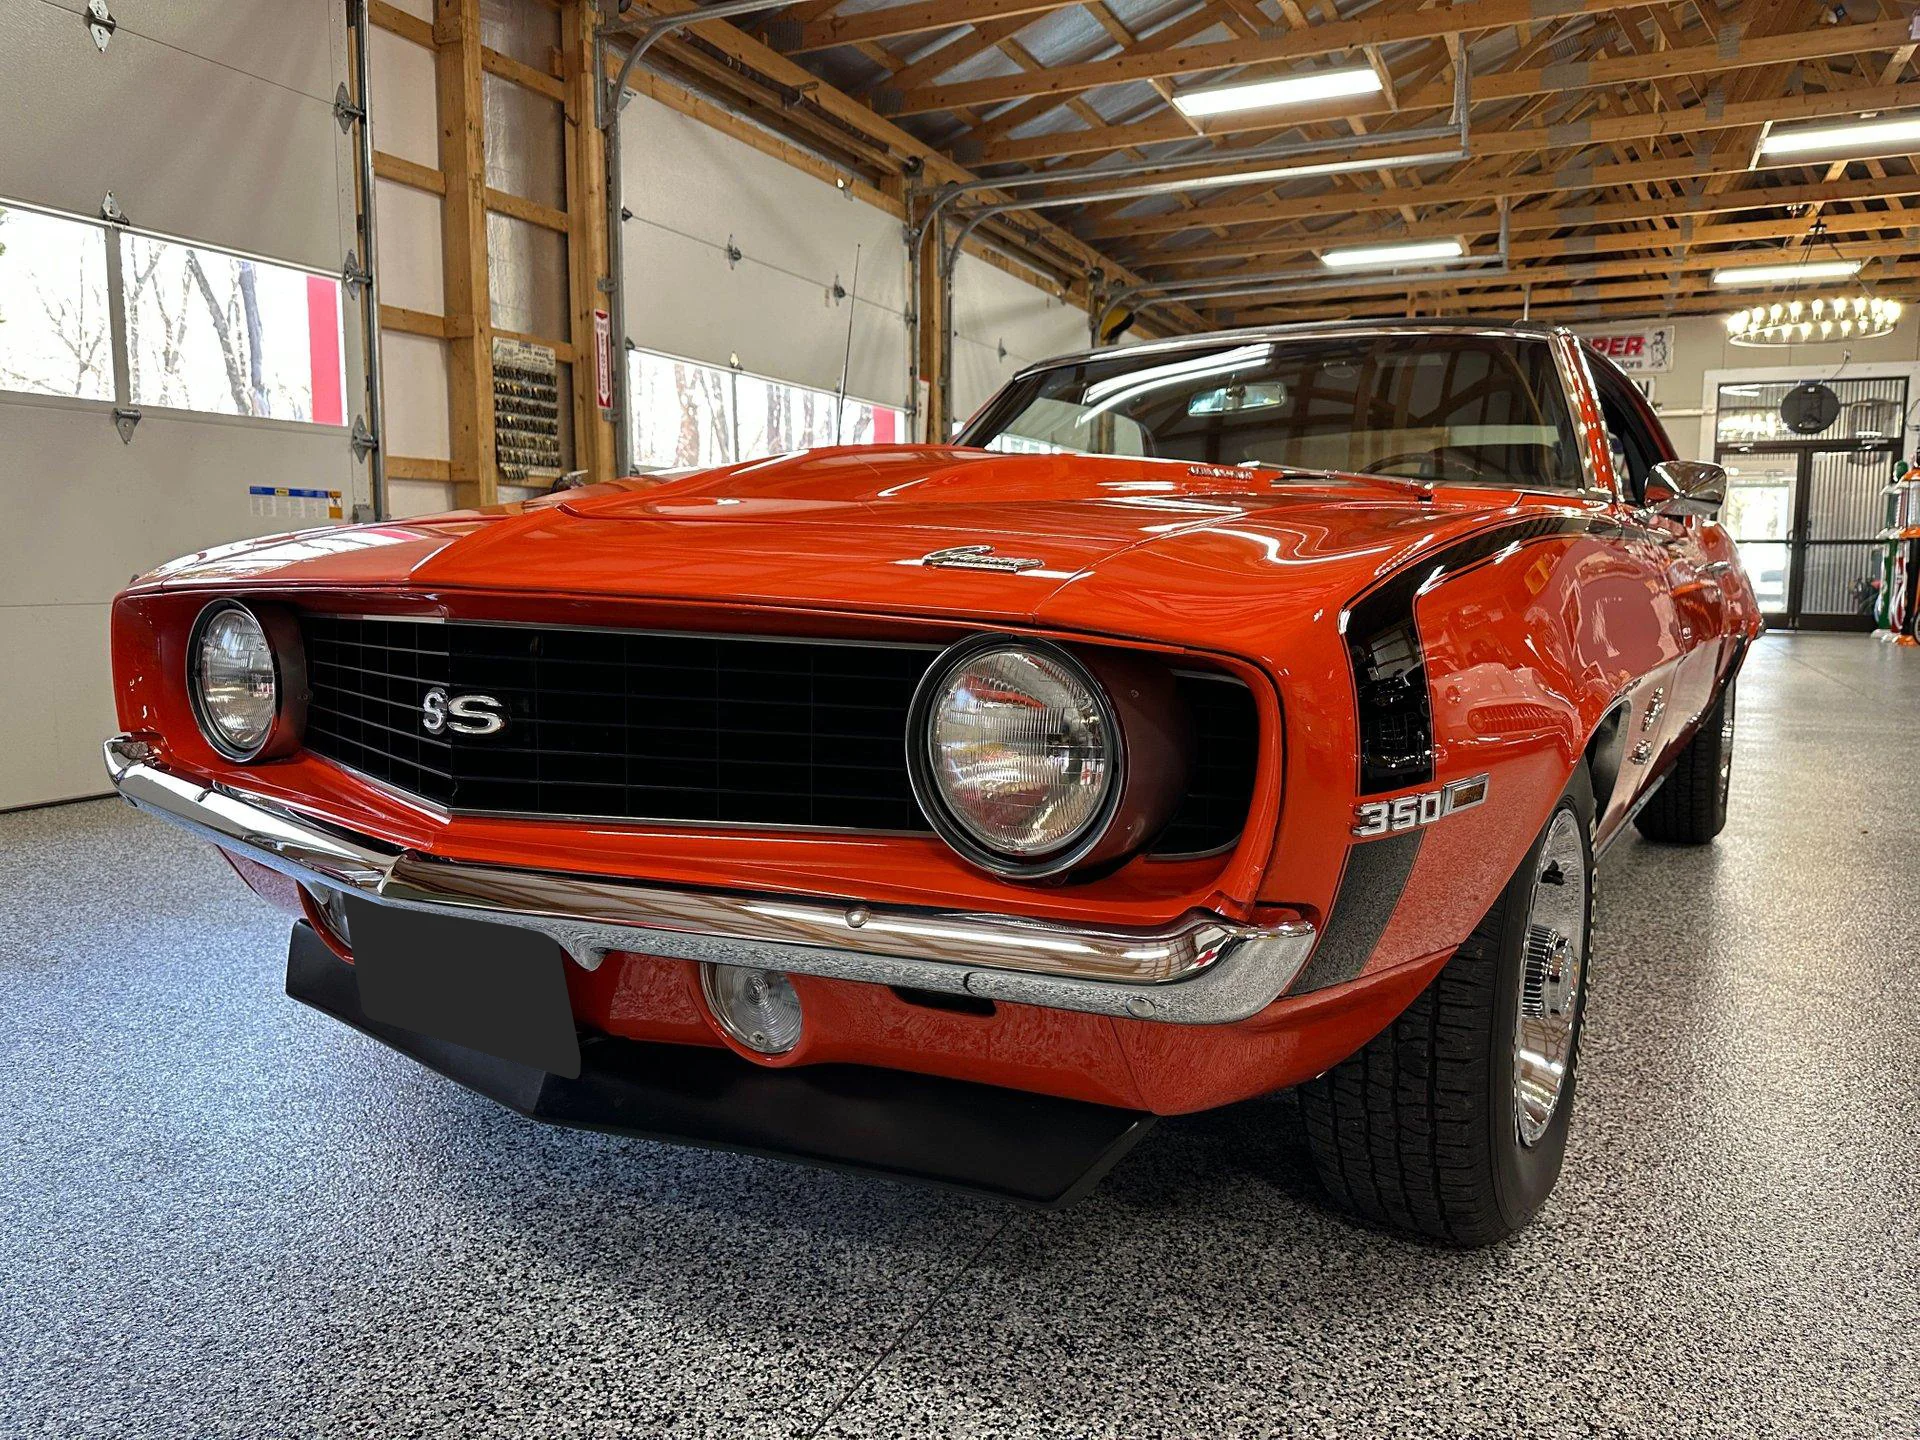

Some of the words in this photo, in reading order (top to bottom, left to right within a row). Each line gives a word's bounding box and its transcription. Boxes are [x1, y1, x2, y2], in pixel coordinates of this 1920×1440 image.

[1587, 336, 1646, 356] PER
[422, 686, 506, 735] SS
[1352, 791, 1441, 837] 350
